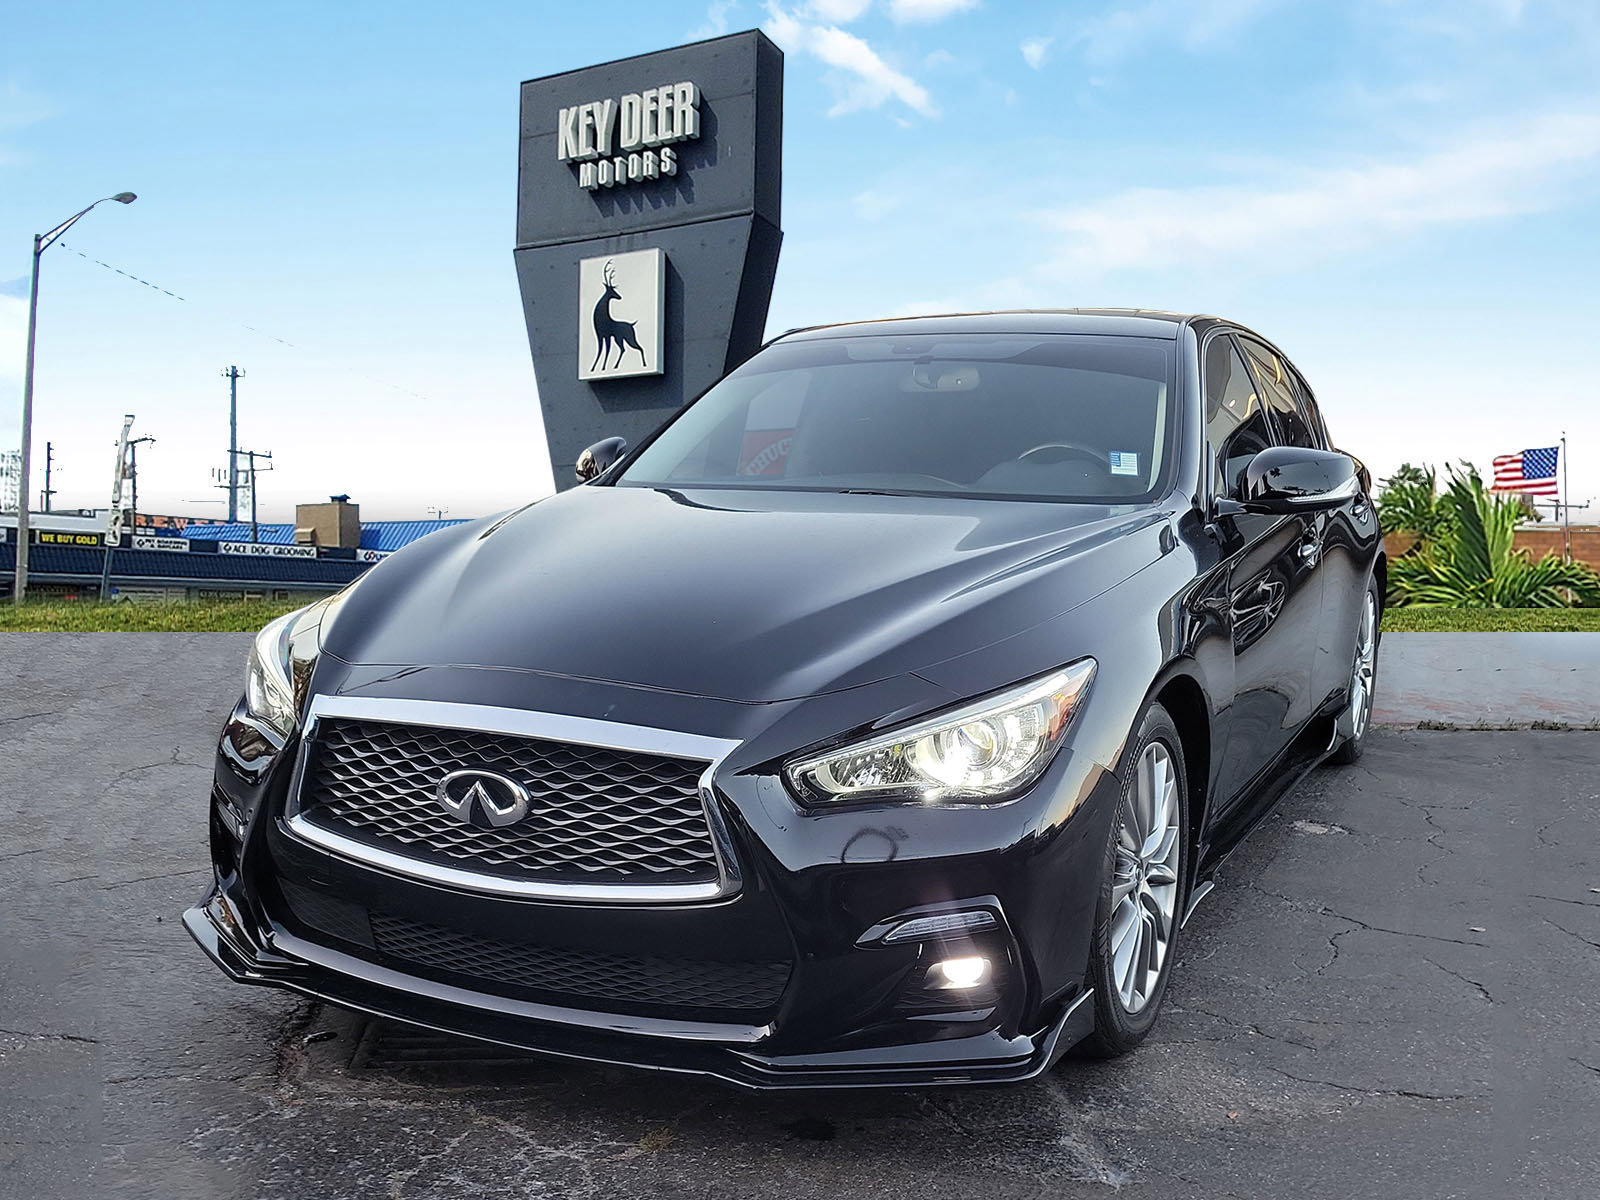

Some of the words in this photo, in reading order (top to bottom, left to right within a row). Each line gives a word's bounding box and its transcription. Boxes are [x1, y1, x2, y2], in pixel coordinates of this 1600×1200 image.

[558, 98, 617, 163] KEY
[620, 81, 700, 152] DEER
[579, 147, 677, 190] MOTORS
[41, 533, 55, 542] WE
[57, 534, 74, 544] BUY
[75, 535, 98, 545] GOLD
[232, 545, 247, 554] ACE
[251, 546, 270, 555] DOG
[273, 547, 315, 557] GROOMING
